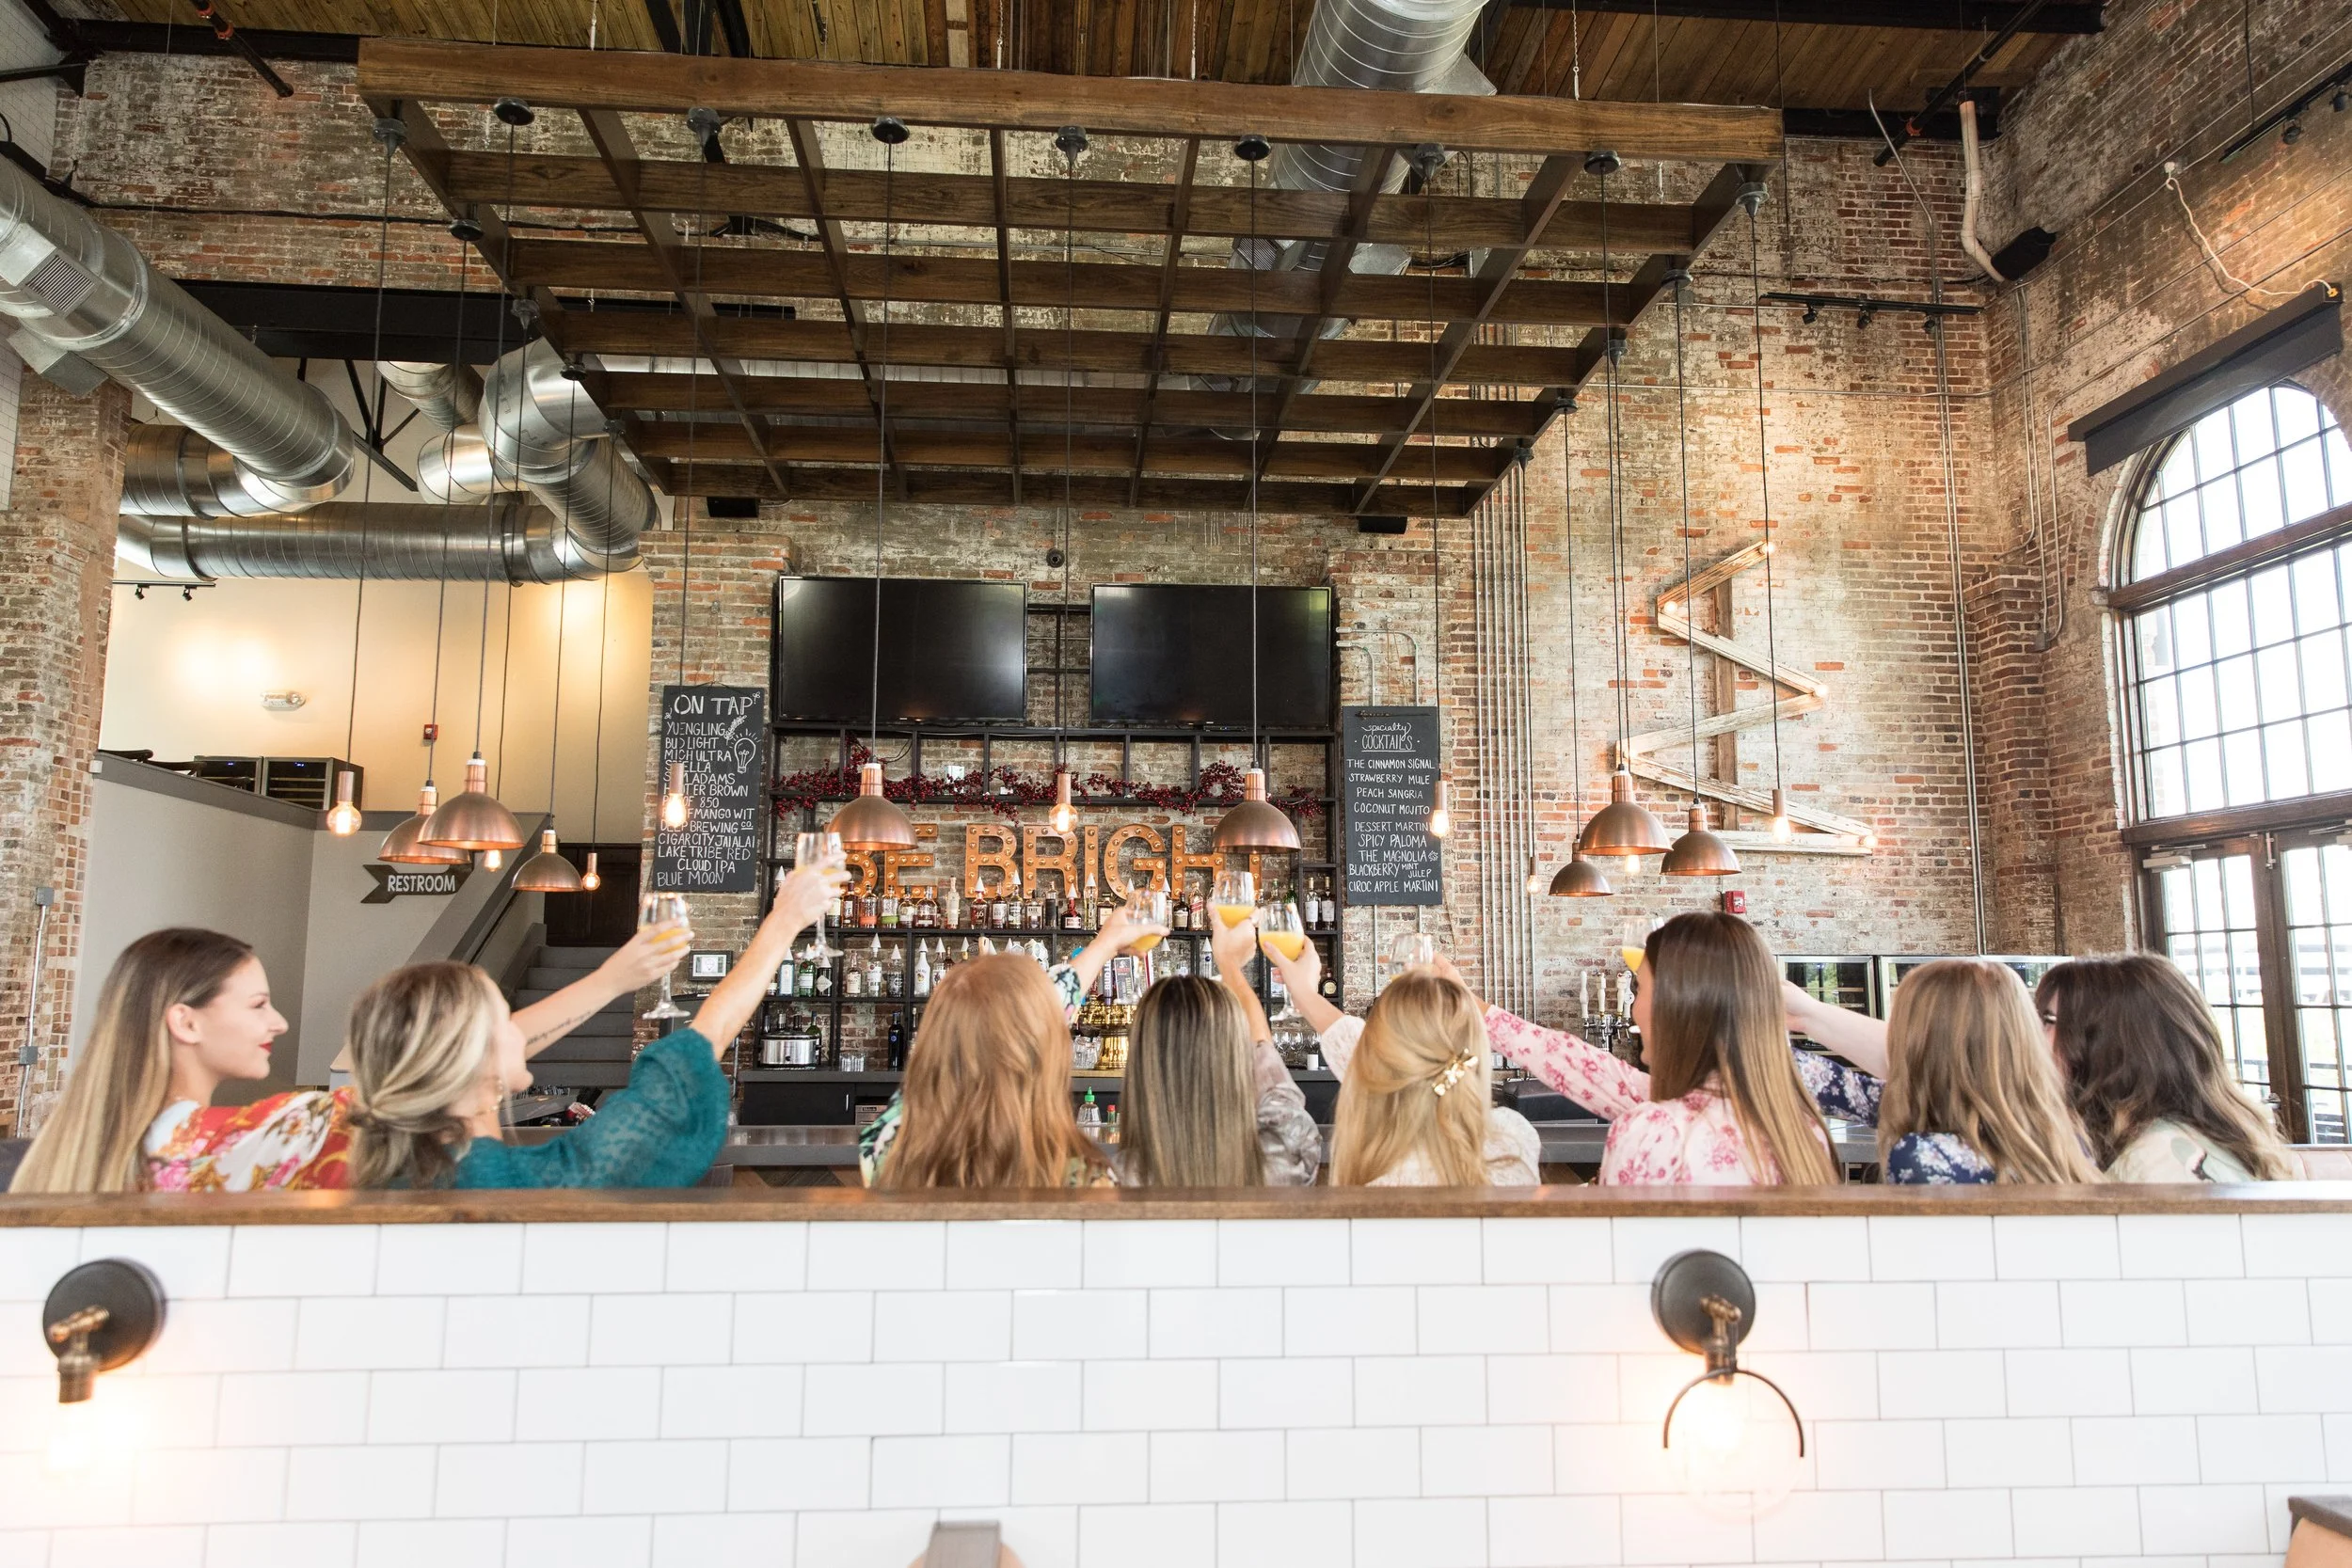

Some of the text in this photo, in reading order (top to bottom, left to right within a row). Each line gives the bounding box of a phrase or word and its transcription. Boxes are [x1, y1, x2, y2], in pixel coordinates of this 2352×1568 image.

[675, 694, 753, 716] ON TAP
[666, 721, 726, 736] YUENGLING
[1361, 721, 1412, 740] specialty
[665, 736, 720, 750] BUD LIGHT
[1361, 734, 1413, 751] COCKTAILS
[664, 749, 732, 762] MICH ULTRA
[664, 759, 711, 773] SELLA
[1346, 758, 1436, 769] THE CINNAMON SIGNAL
[662, 771, 736, 785] SM ADAMS
[1348, 772, 1431, 785] STRAWBERRY MULE
[663, 783, 749, 797] HTER BROWN
[1356, 786, 1423, 800] PEACH SANGRIA
[662, 795, 720, 808] POF 850
[1354, 801, 1430, 816] COCONUT MOJITO
[693, 808, 732, 819] MANGO
[734, 808, 755, 820] WIT
[690, 820, 739, 833] BREWING
[1355, 821, 1392, 832] DESSERT
[658, 832, 691, 846] CIGAR
[691, 832, 715, 846] CITY
[1358, 833, 1428, 848] SPICY PALOMA
[658, 846, 751, 861] LAKE TRIBE RED
[1358, 848, 1428, 863] THE MAGNOLIA
[677, 858, 736, 874] CLOUD IPA
[1348, 863, 1401, 878] BLACKBERRY
[657, 870, 725, 887] BLUE MOON
[1407, 868, 1432, 879] JULEP
[387, 874, 456, 893] RESTROOM
[1348, 879, 1438, 893] CIROC APPLE MARTINI
